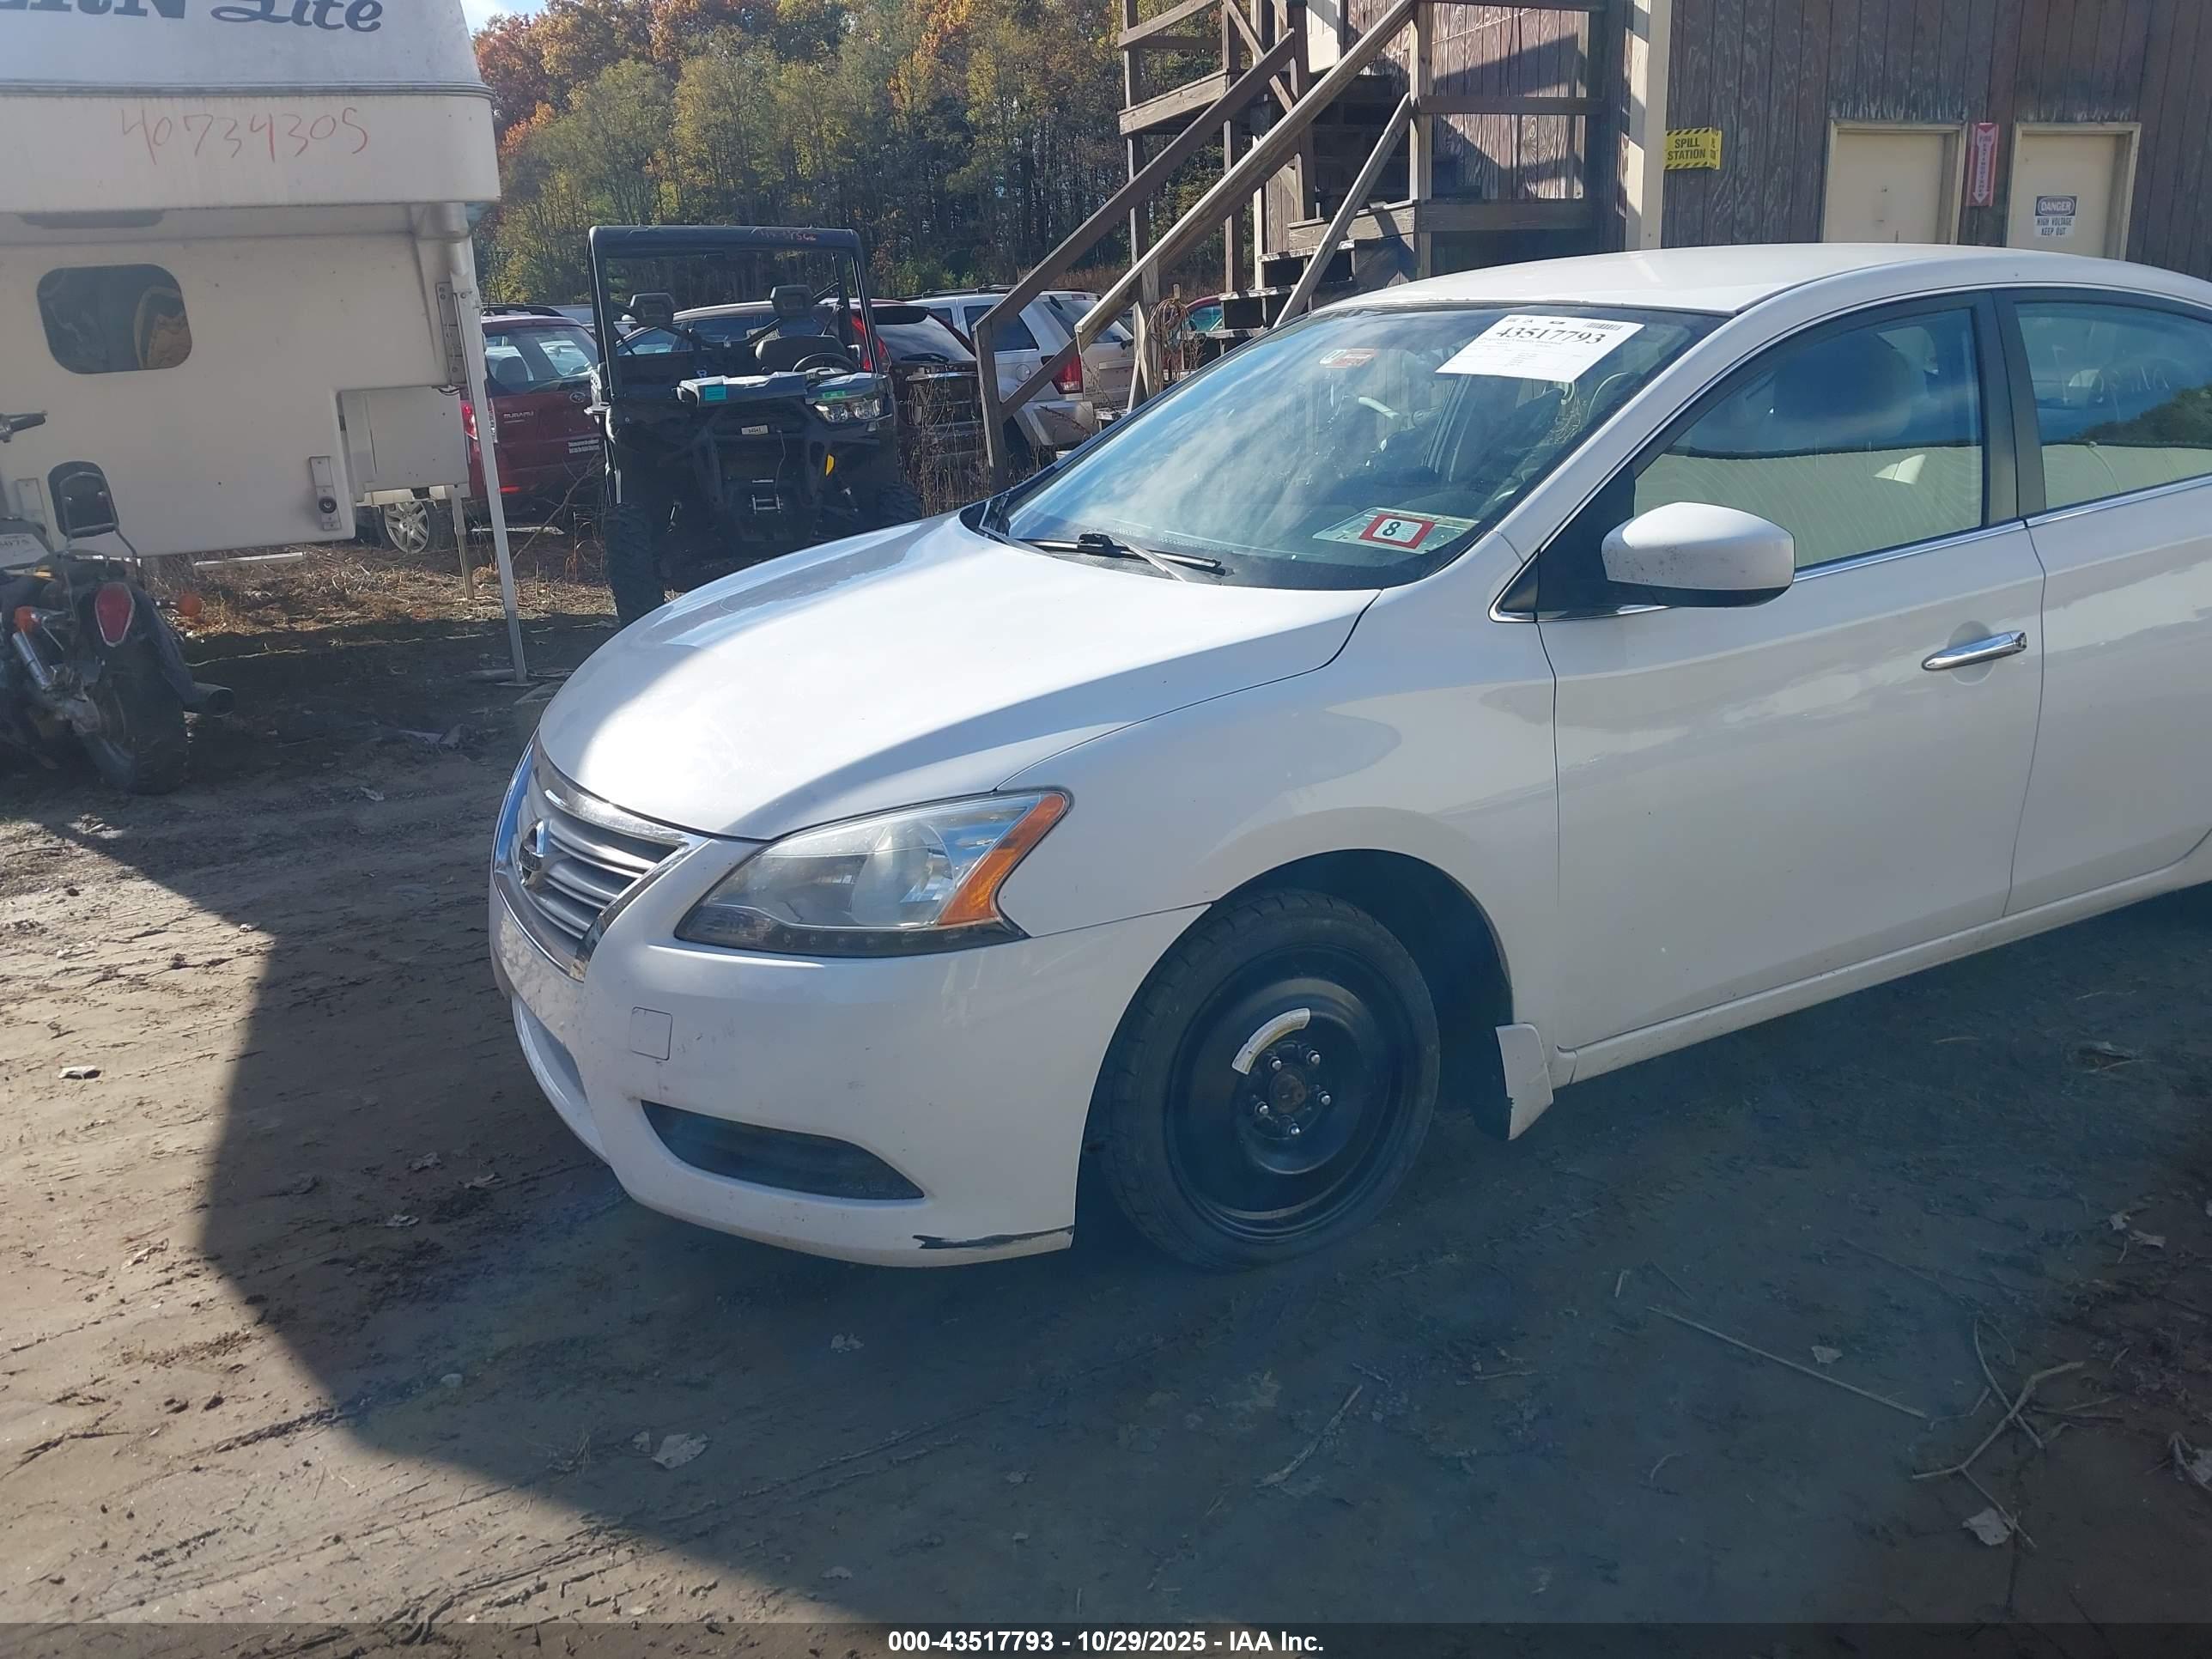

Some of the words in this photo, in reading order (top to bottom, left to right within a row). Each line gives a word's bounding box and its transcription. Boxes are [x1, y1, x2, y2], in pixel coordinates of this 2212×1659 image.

[121, 106, 368, 166] 40734305
[1674, 137, 1700, 149] SPILL
[1668, 149, 1706, 161] STATION
[2040, 200, 2072, 212] DANGER
[2037, 217, 2050, 227] HIGH
[2051, 216, 2073, 226] VOLTAGE
[2041, 227, 2054, 236] KEEP
[2056, 227, 2067, 236] OUT
[1495, 326, 1607, 344] 43517793
[1382, 520, 1401, 537] 8
